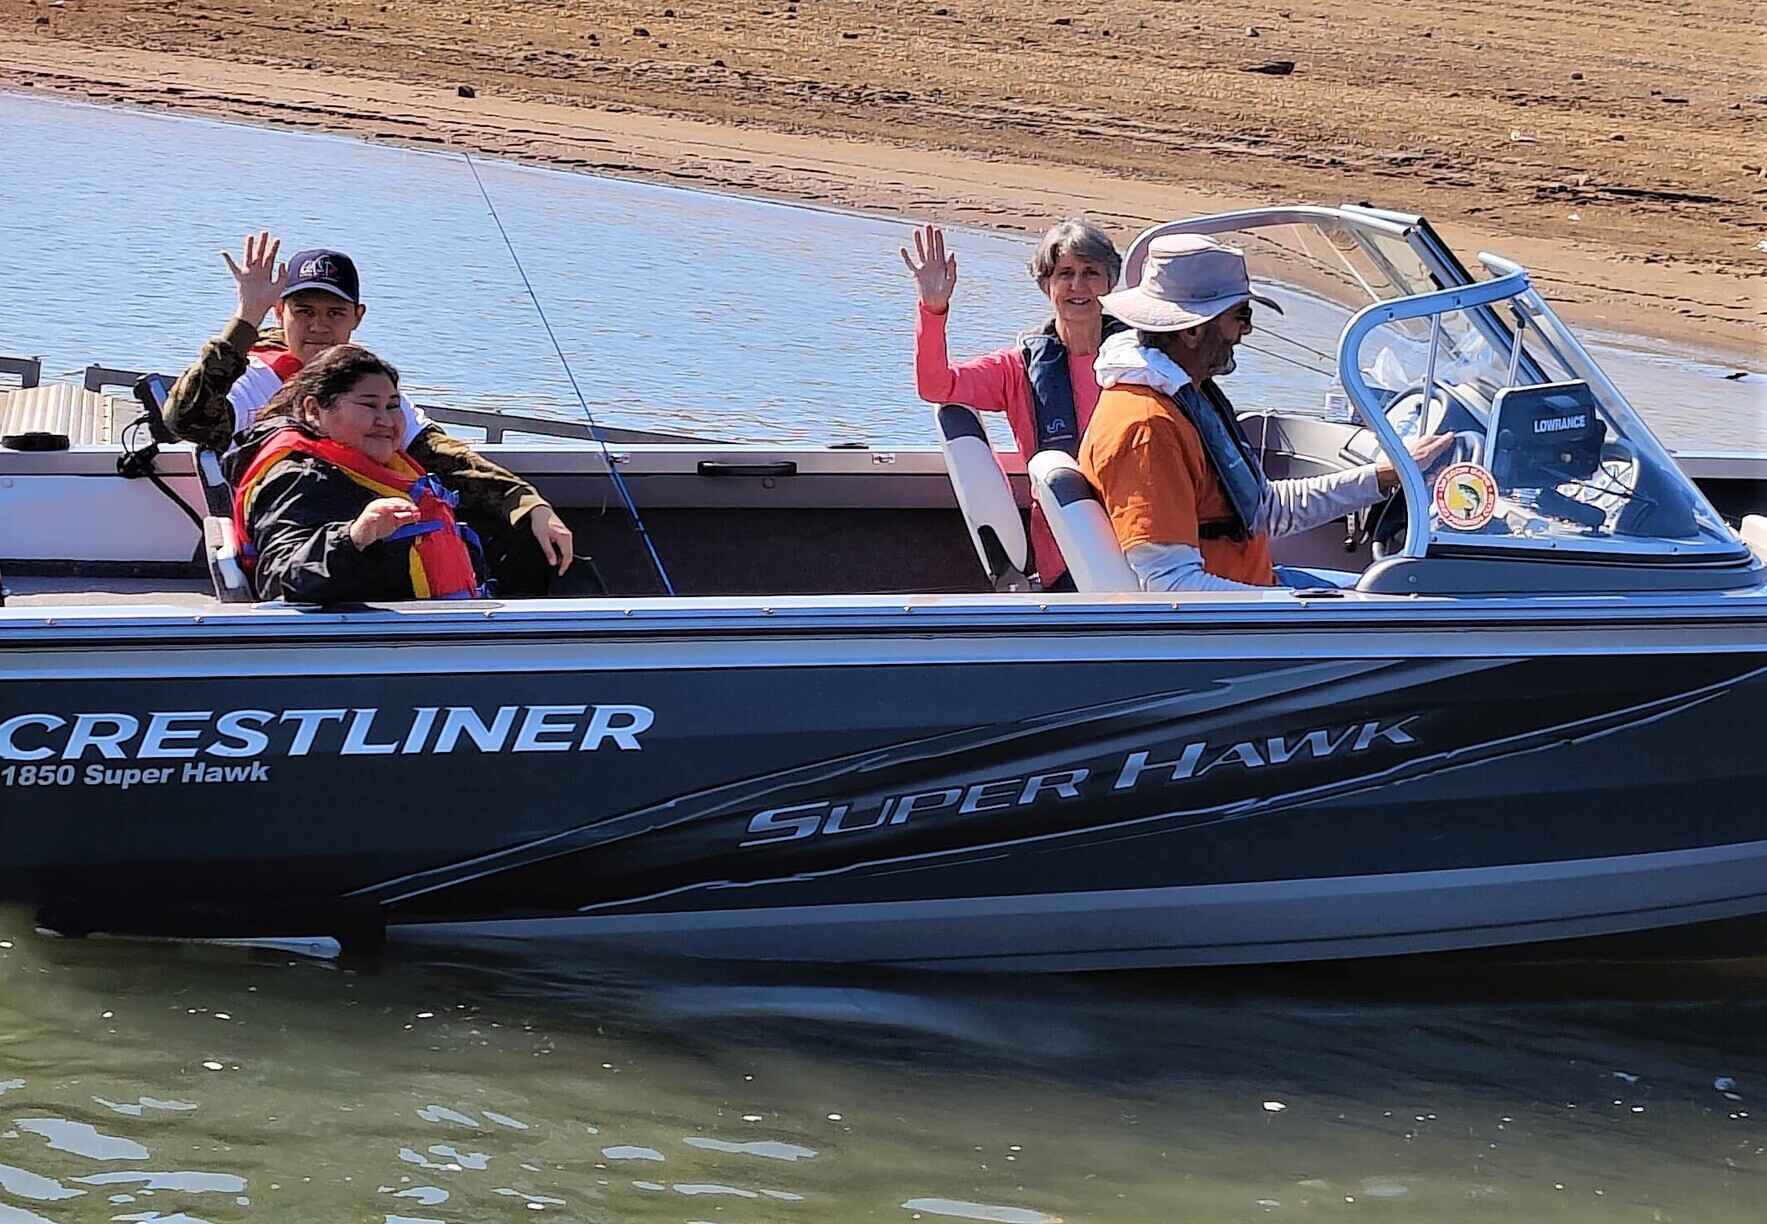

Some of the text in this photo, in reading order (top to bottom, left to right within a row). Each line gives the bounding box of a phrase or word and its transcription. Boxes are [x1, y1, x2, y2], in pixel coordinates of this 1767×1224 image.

[1534, 415, 1586, 433] LOWRANCE
[0, 704, 655, 760] CRESTLINER
[1, 761, 271, 789] 1850 Super Hawk
[739, 715, 1420, 847] SUPER HAWK
